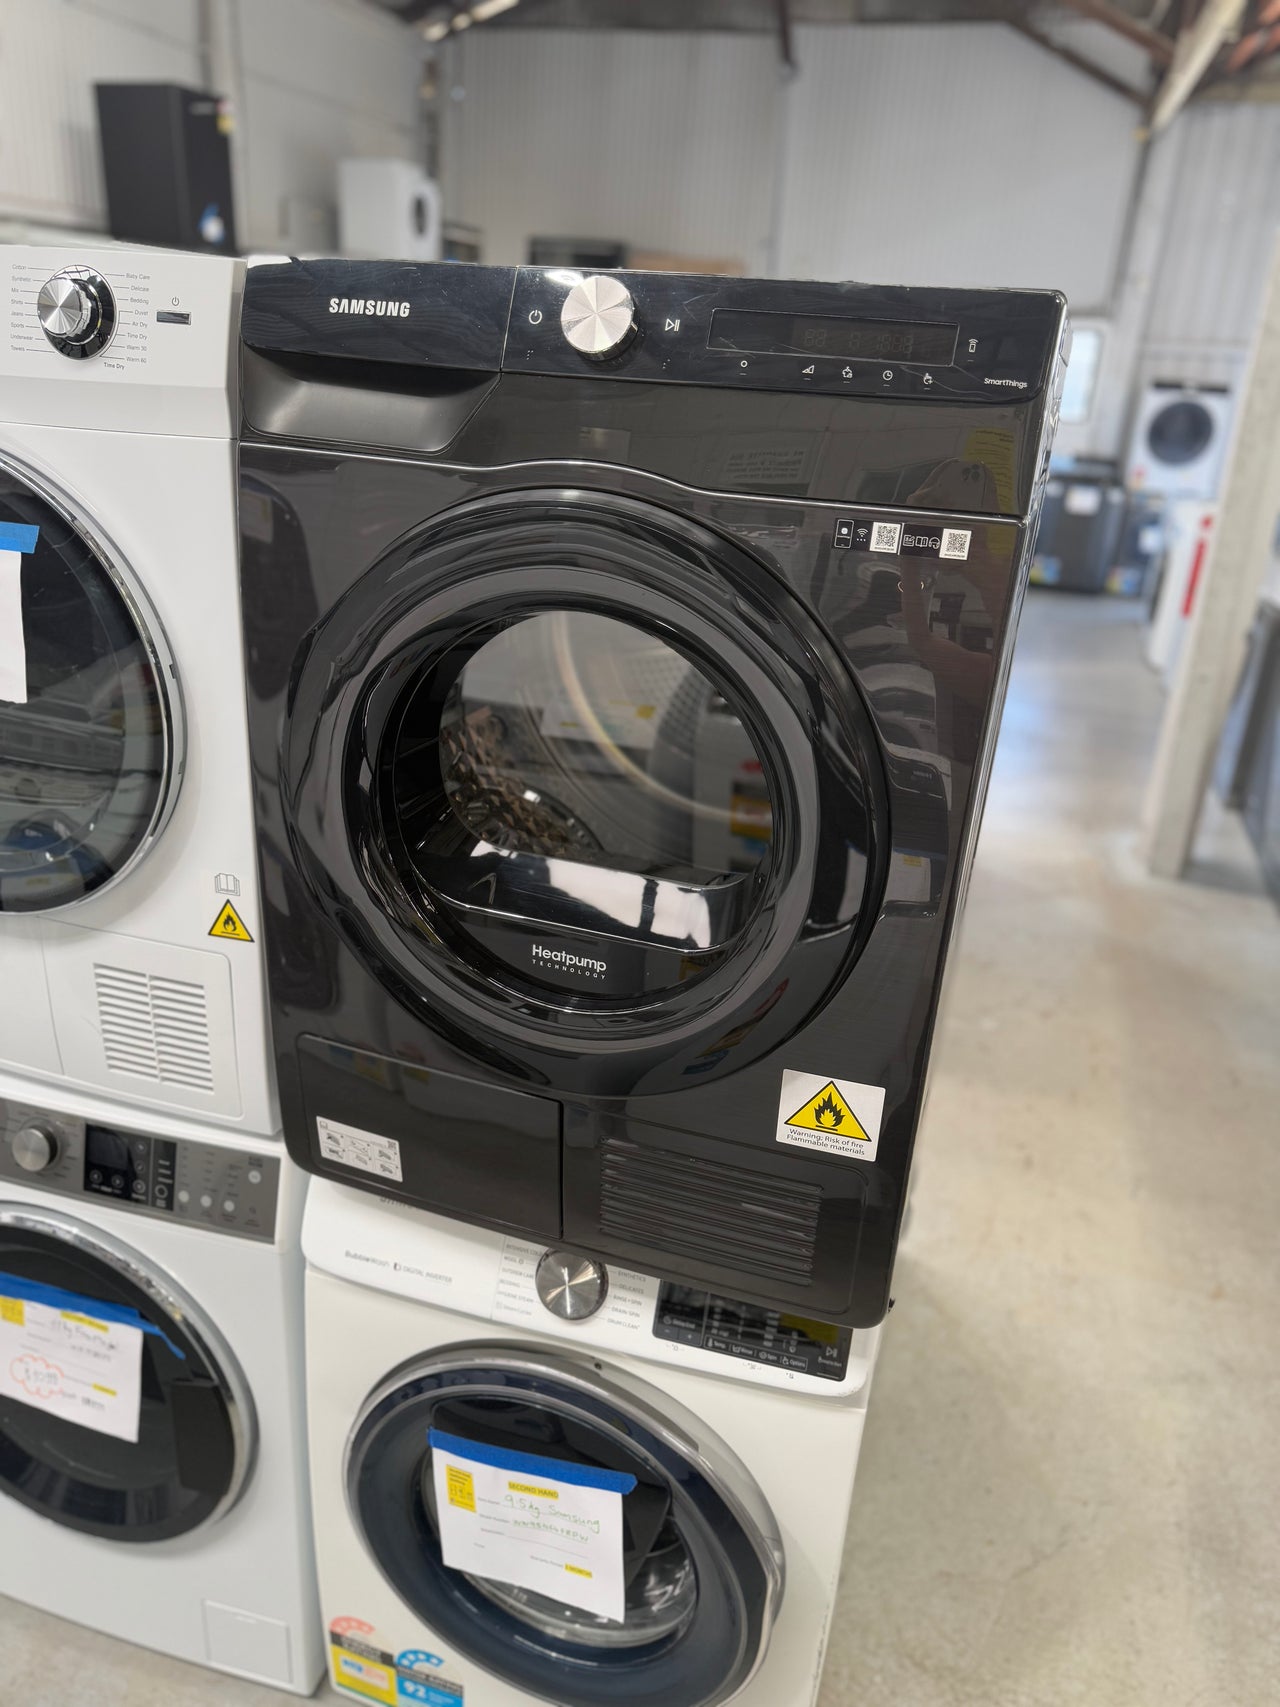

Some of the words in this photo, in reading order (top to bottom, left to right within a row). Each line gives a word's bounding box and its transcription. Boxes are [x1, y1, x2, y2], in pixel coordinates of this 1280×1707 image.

[328, 297, 411, 318] SAMSUNG
[984, 377, 1028, 390] SmartThings
[532, 944, 607, 972] Heatpump
[532, 959, 606, 980] TECHNOLOGY
[787, 1133, 829, 1148] Flammable
[830, 1144, 865, 1155] materials
[789, 1128, 823, 1141] Warning:
[825, 1135, 840, 1144] Risk
[851, 1141, 864, 1149] fire
[509, 1481, 537, 1494] SECOND
[538, 1487, 559, 1499] HAND
